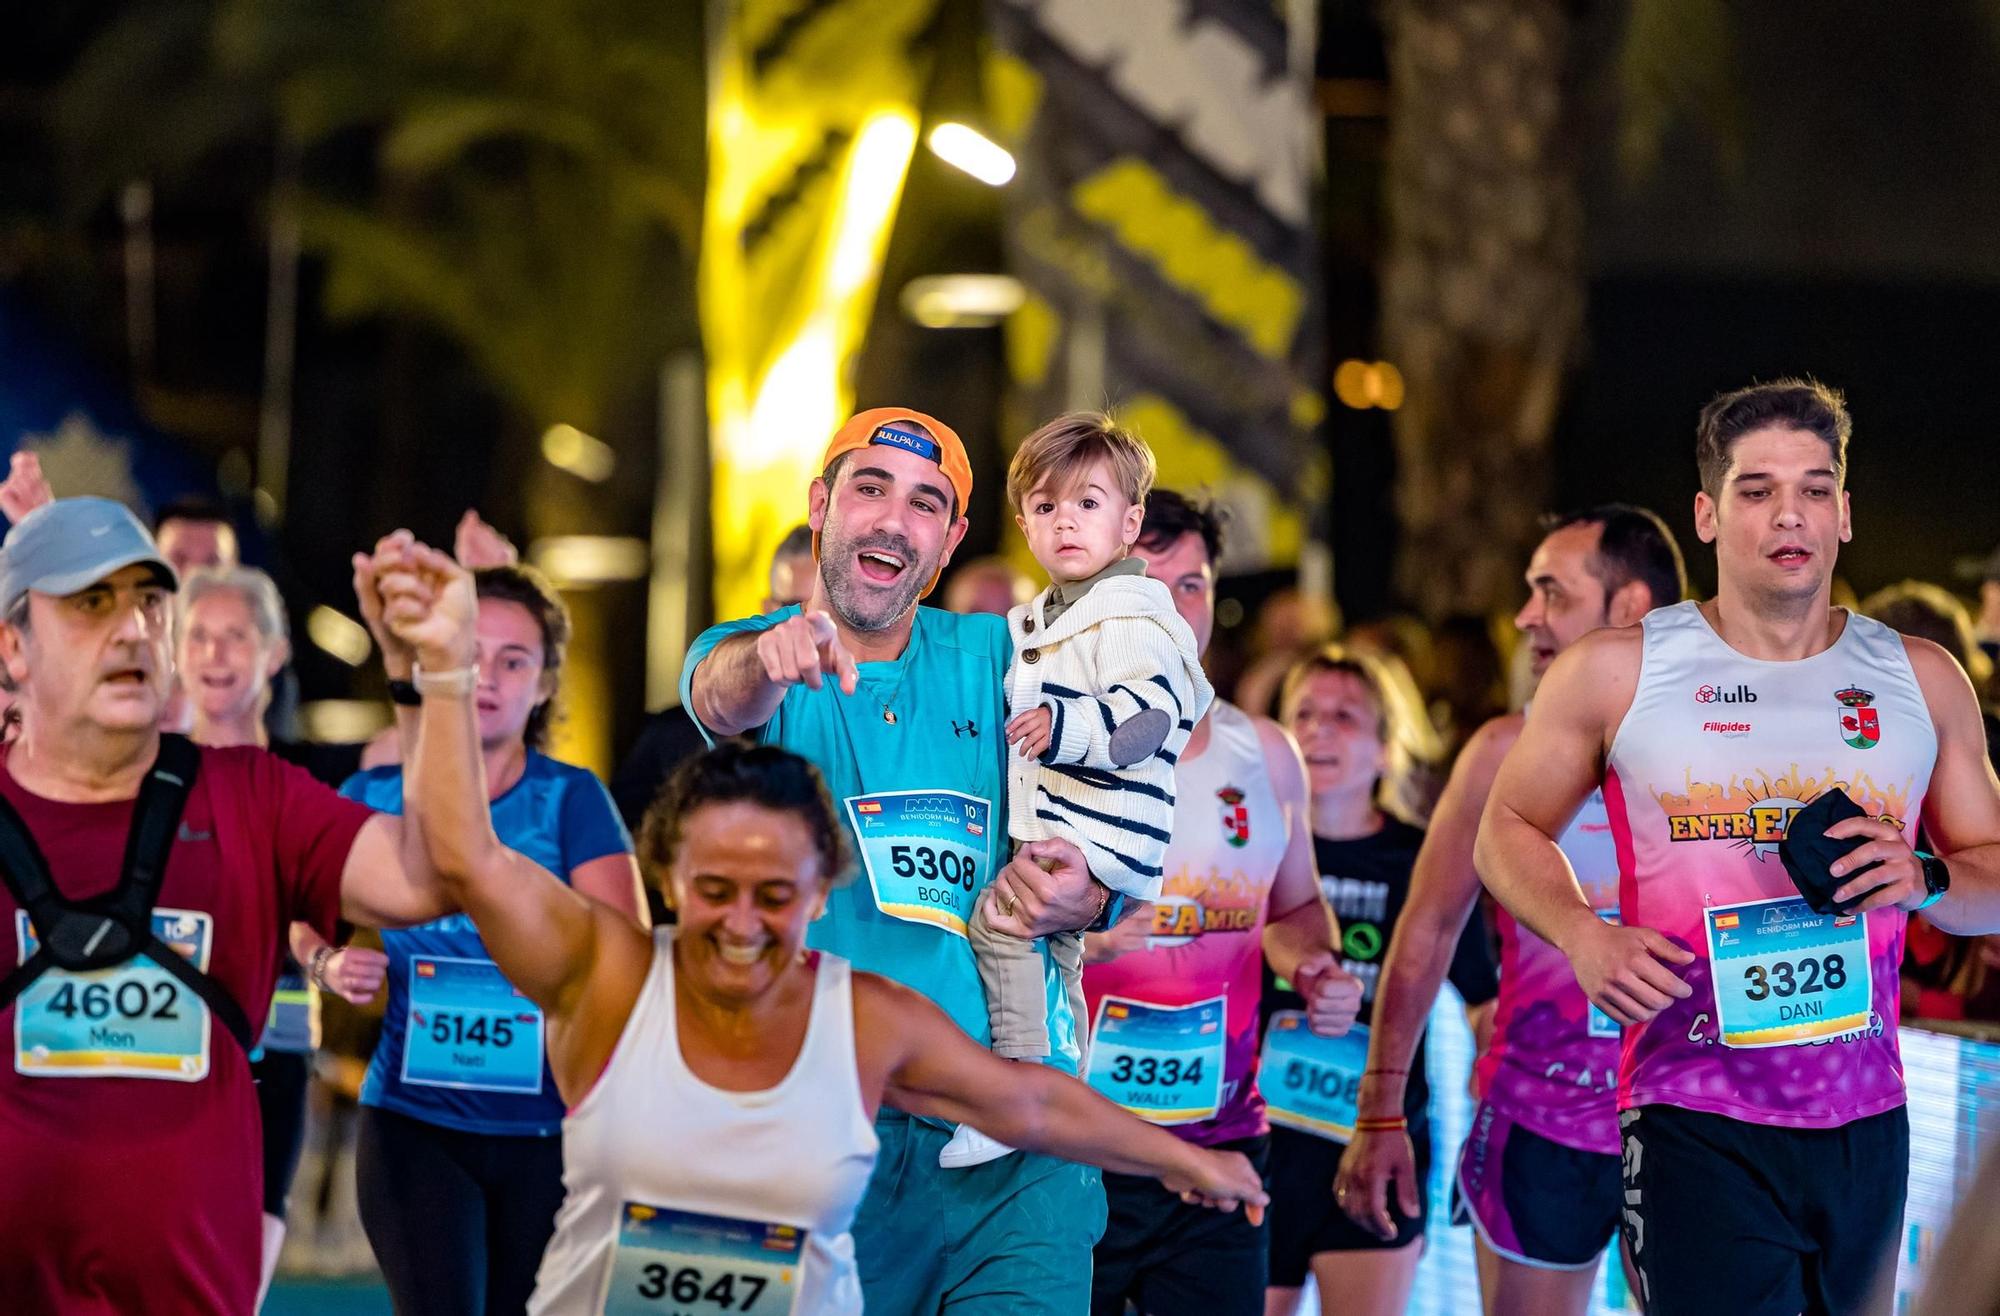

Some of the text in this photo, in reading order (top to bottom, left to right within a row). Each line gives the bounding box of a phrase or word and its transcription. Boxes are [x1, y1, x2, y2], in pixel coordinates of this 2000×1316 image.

[1703, 722, 1752, 733] Filipides
[900, 812, 960, 824] BENIDORM HALF
[891, 846, 976, 892] 5308
[1756, 922, 1800, 935] BENIDORM
[1802, 918, 1824, 929] HALF
[1744, 954, 1847, 1001] 3328
[46, 981, 178, 1019] 4602
[1779, 1000, 1823, 1021] DANI
[431, 1013, 514, 1048] 5145
[1111, 1055, 1204, 1087] 3334
[1127, 1090, 1182, 1106] WALLY
[637, 1263, 769, 1312] 3647
